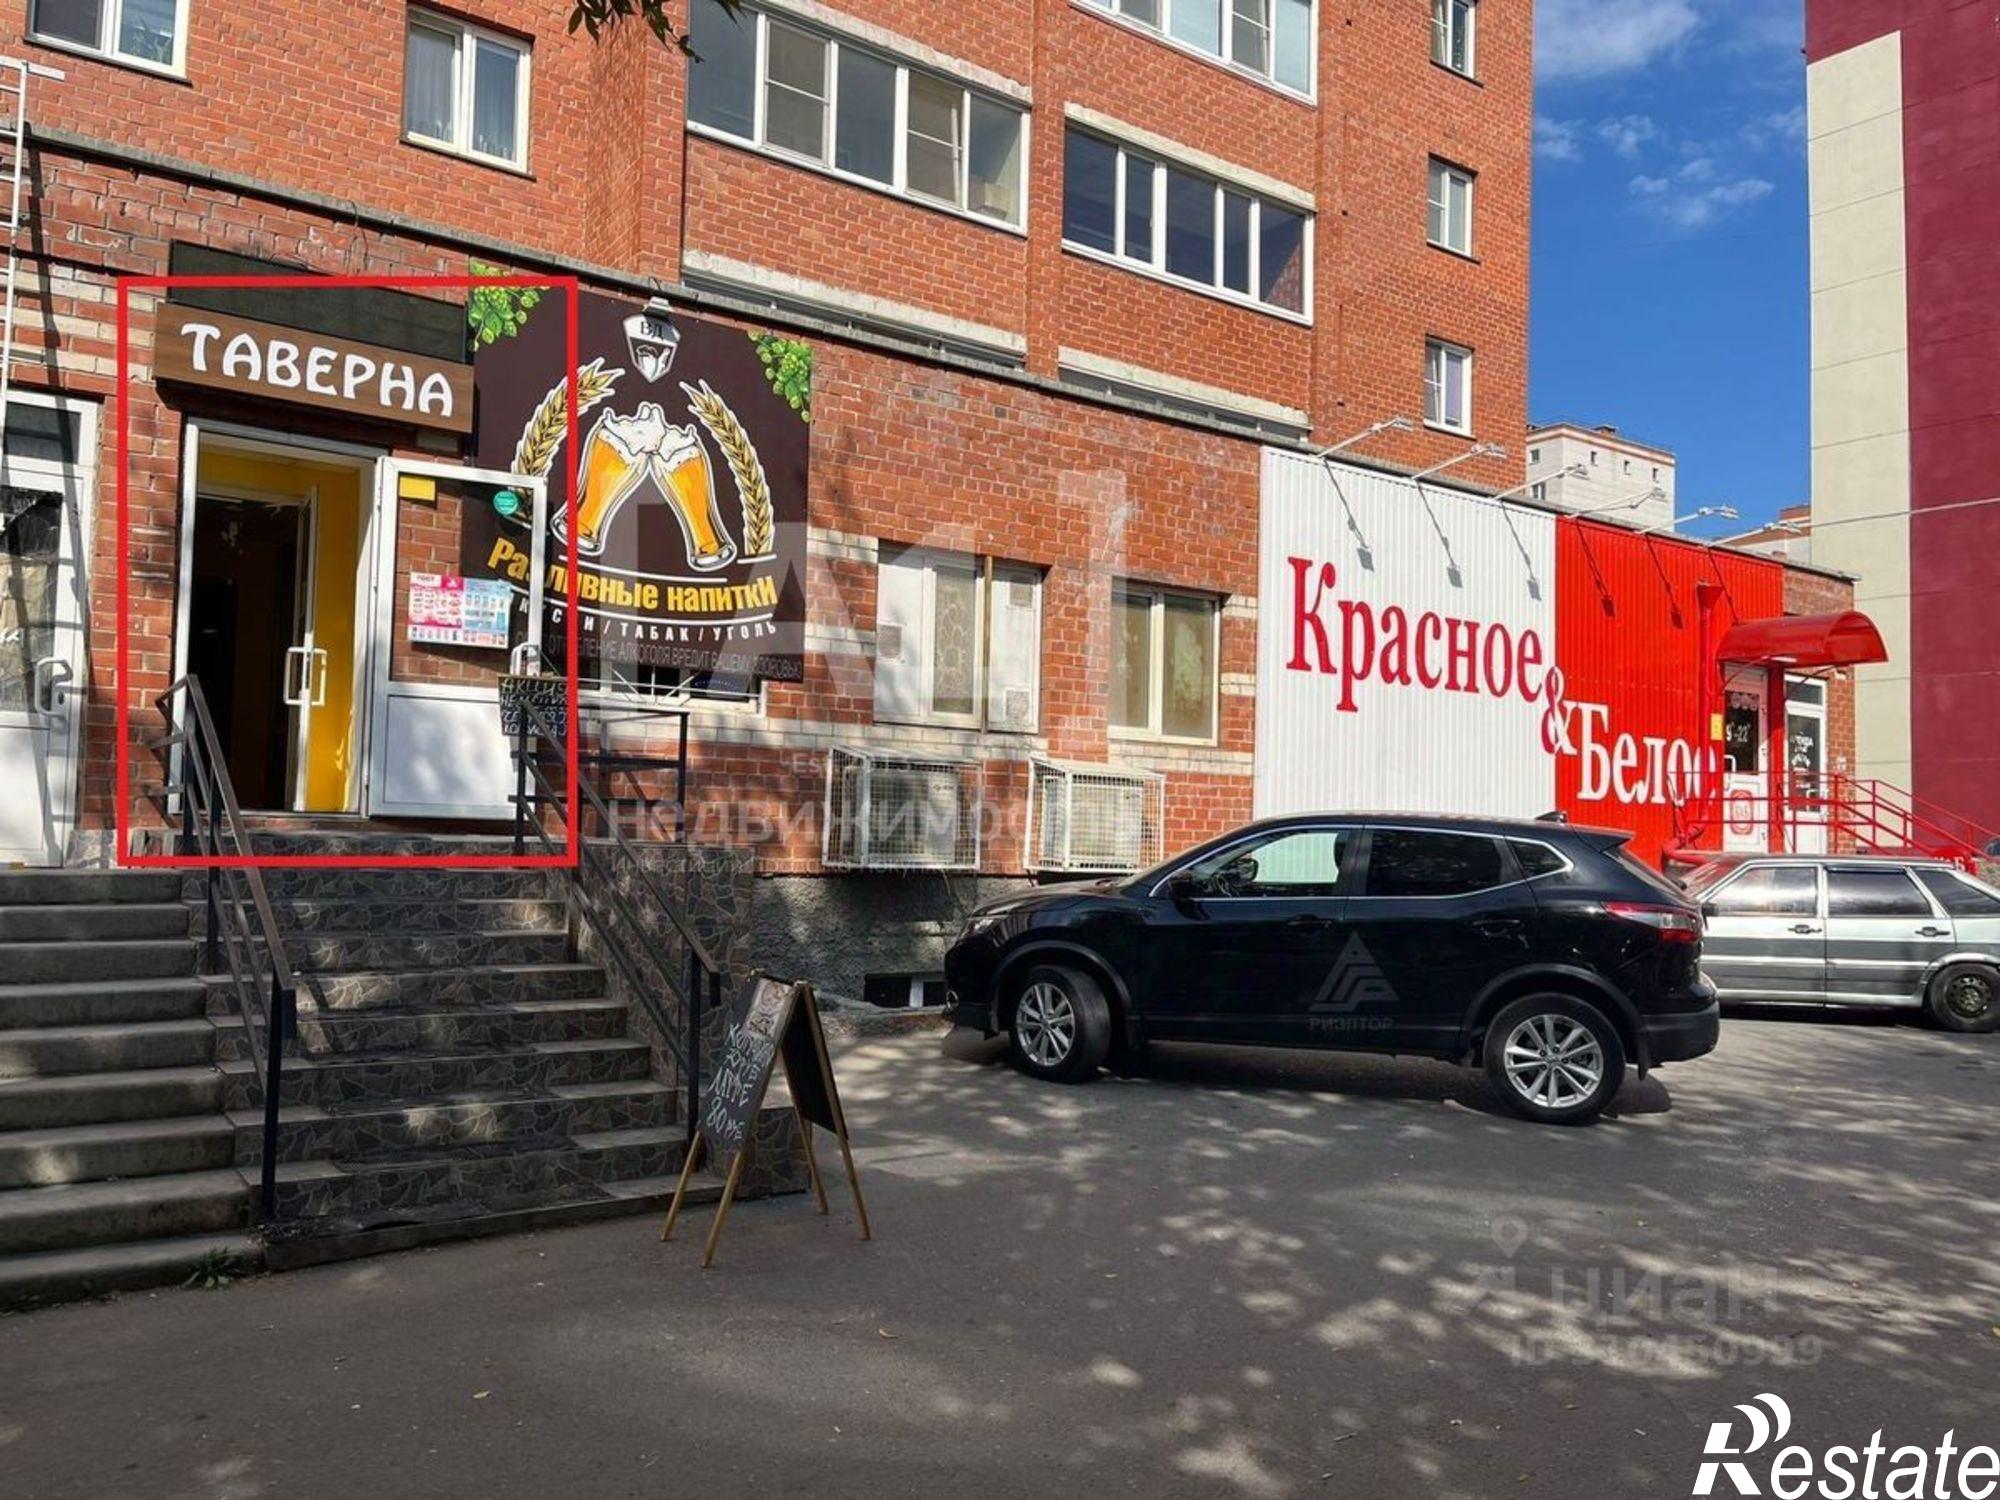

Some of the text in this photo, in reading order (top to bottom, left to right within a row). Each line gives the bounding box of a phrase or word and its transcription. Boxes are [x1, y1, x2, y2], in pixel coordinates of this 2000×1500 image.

[180, 322, 453, 418] ТАВЕРНА
[487, 537, 778, 612] Ралвные напитки
[620, 622, 690, 642] ТАБАК
[712, 621, 777, 642] УГОЛЬ
[1286, 556, 1543, 712] Красное
